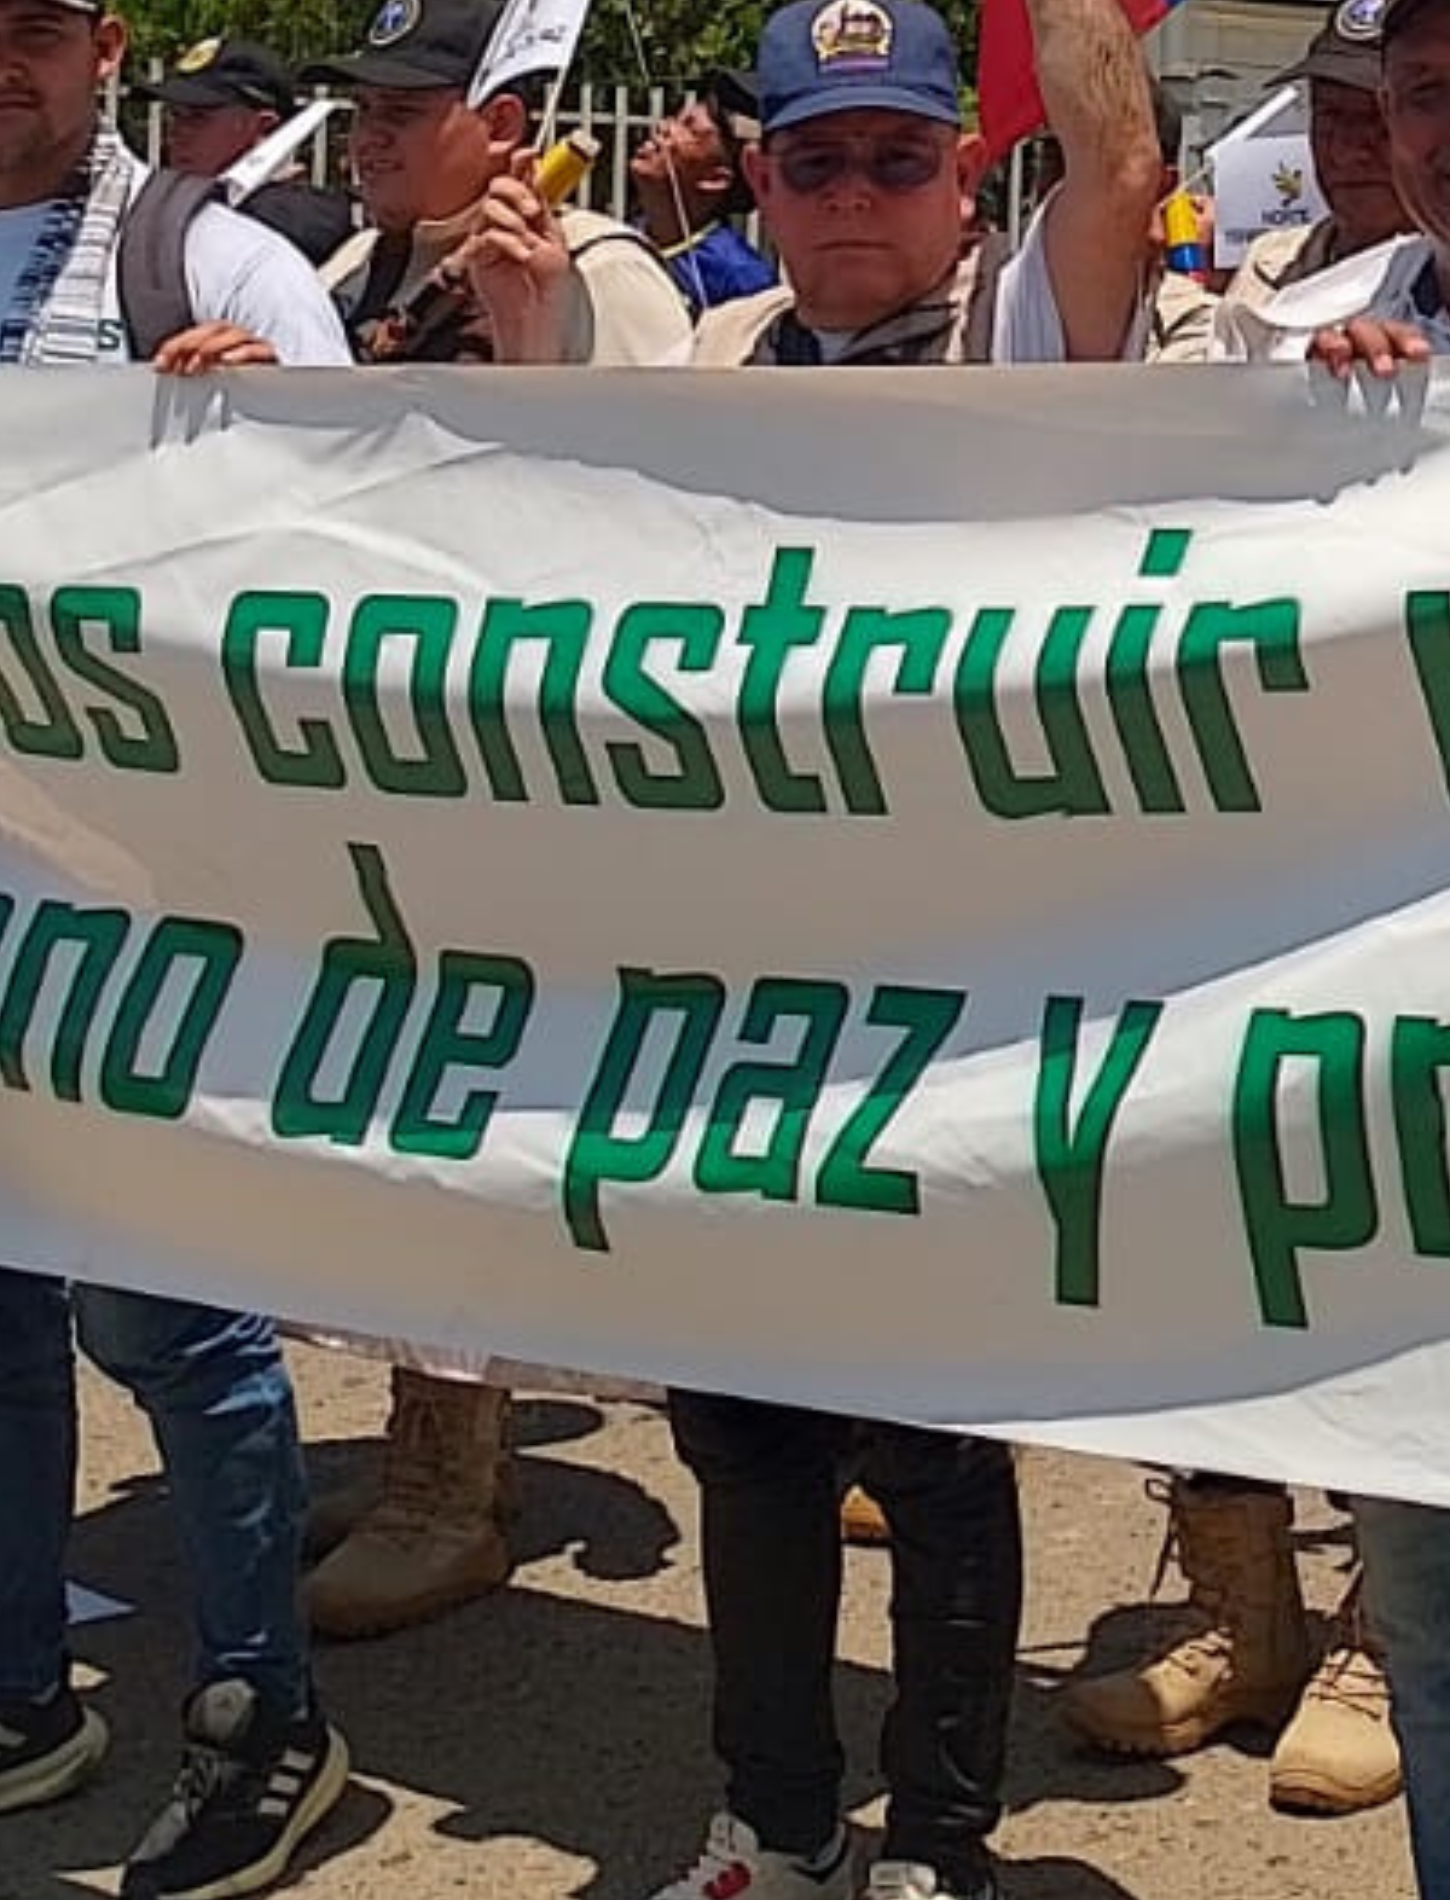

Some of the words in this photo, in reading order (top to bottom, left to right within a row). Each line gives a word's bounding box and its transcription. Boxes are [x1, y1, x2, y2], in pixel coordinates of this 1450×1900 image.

[221, 528, 1311, 819] construir
[271, 840, 535, 1161] de
[562, 965, 968, 1253] paz
[1033, 995, 1164, 1307] y
